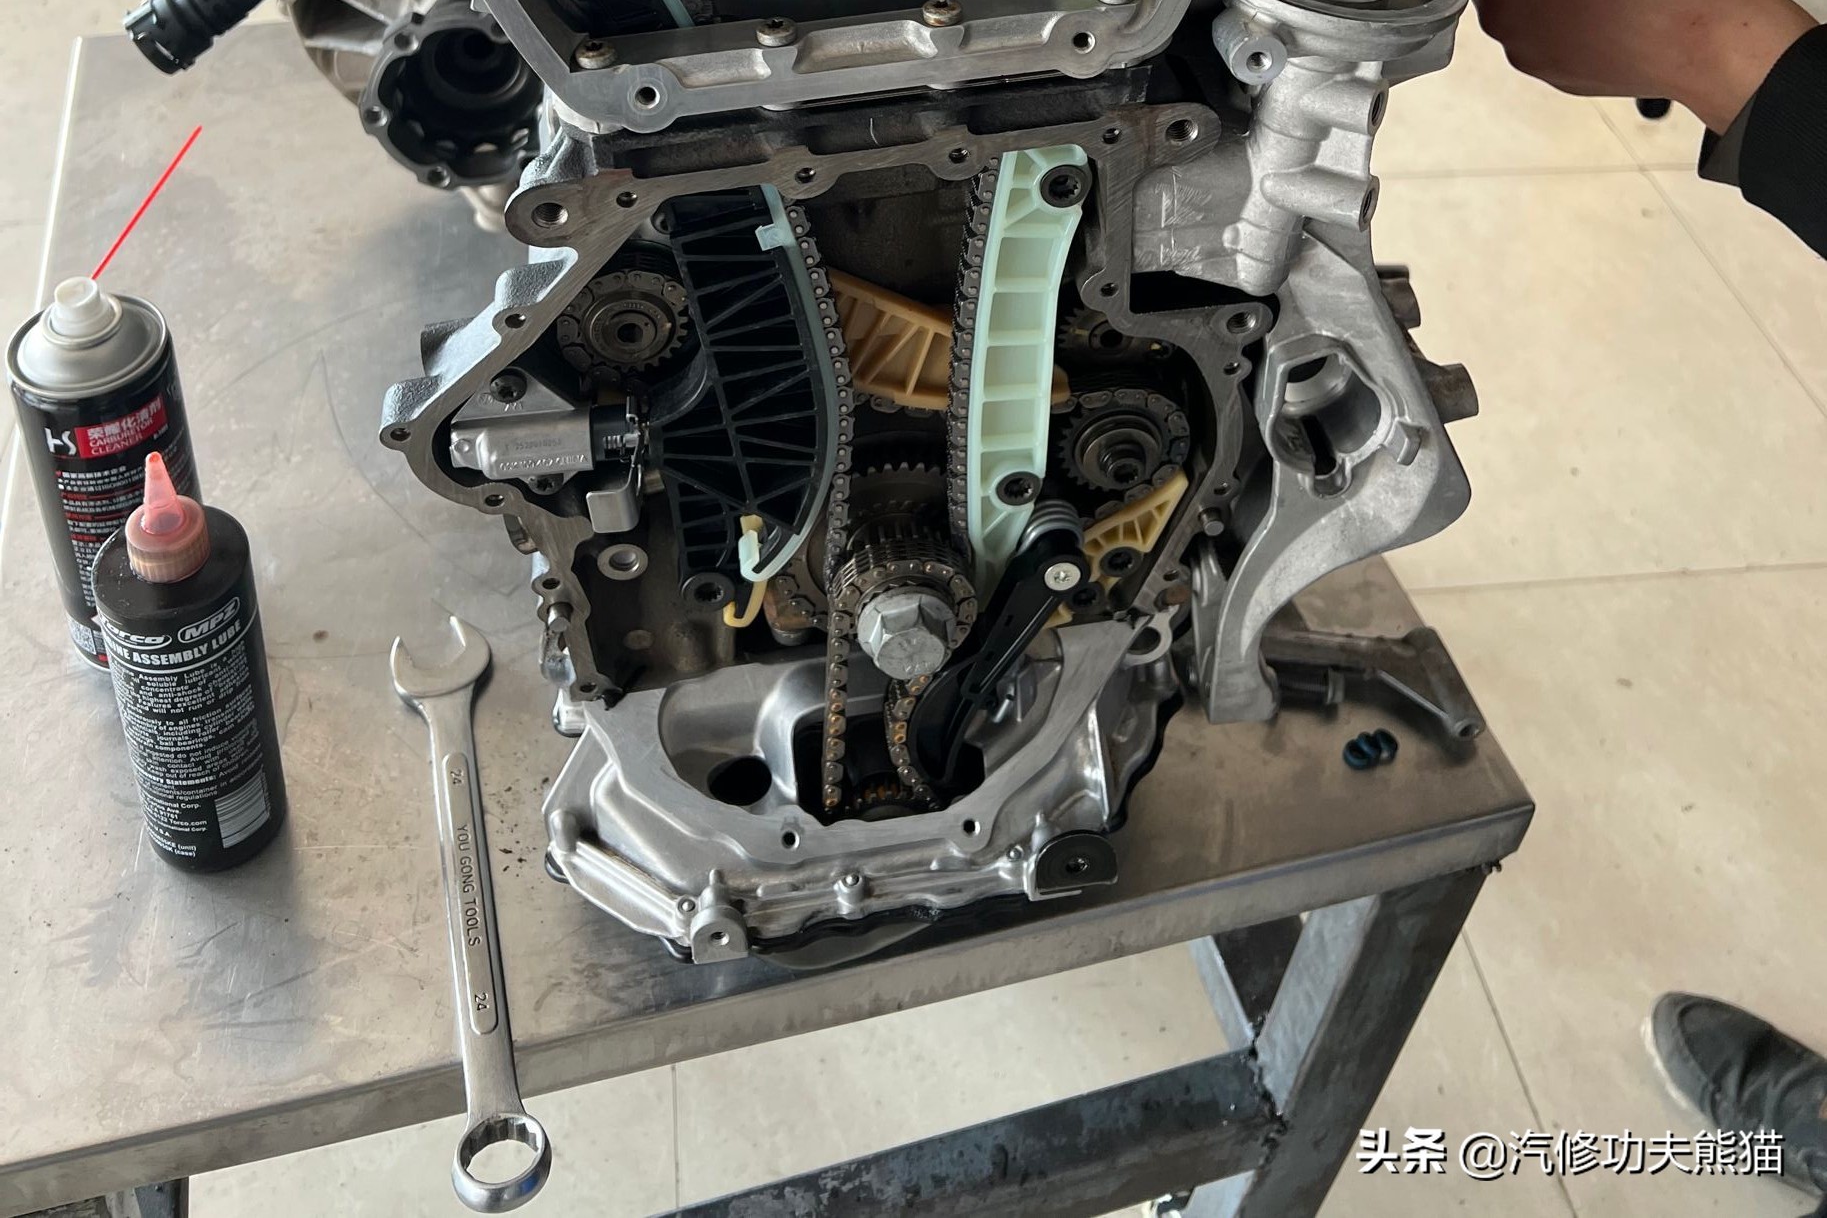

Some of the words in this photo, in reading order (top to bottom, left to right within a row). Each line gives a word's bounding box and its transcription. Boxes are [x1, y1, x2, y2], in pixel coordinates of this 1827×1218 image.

[91, 434, 144, 455] CLEANER
[184, 600, 237, 641] MPZ
[132, 643, 209, 666] ASSEMBLY
[211, 618, 242, 650] LUBE
[138, 673, 178, 683] Assembly
[183, 668, 205, 679] Lube
[185, 665, 222, 684] lubricant
[140, 685, 190, 693] concentrate
[158, 686, 203, 698] anti-shock
[142, 695, 172, 704] highest
[173, 692, 203, 703] degree
[177, 692, 215, 708] excellent
[188, 703, 203, 711] run
[192, 708, 222, 722] friction
[163, 728, 202, 736] including
[198, 725, 220, 737] roller
[190, 753, 212, 763] Avoid
[170, 766, 203, 774] exposed
[188, 770, 211, 778] reach
[166, 775, 217, 786] Statements:
[175, 790, 218, 801] regulations
[169, 818, 208, 826] Torco.com
[457, 824, 471, 851] YOU
[174, 849, 196, 857] (case)
[177, 844, 197, 852] (unit)
[460, 858, 476, 894] GONG
[464, 898, 481, 947] TOOLS
[474, 992, 489, 1012] 24
